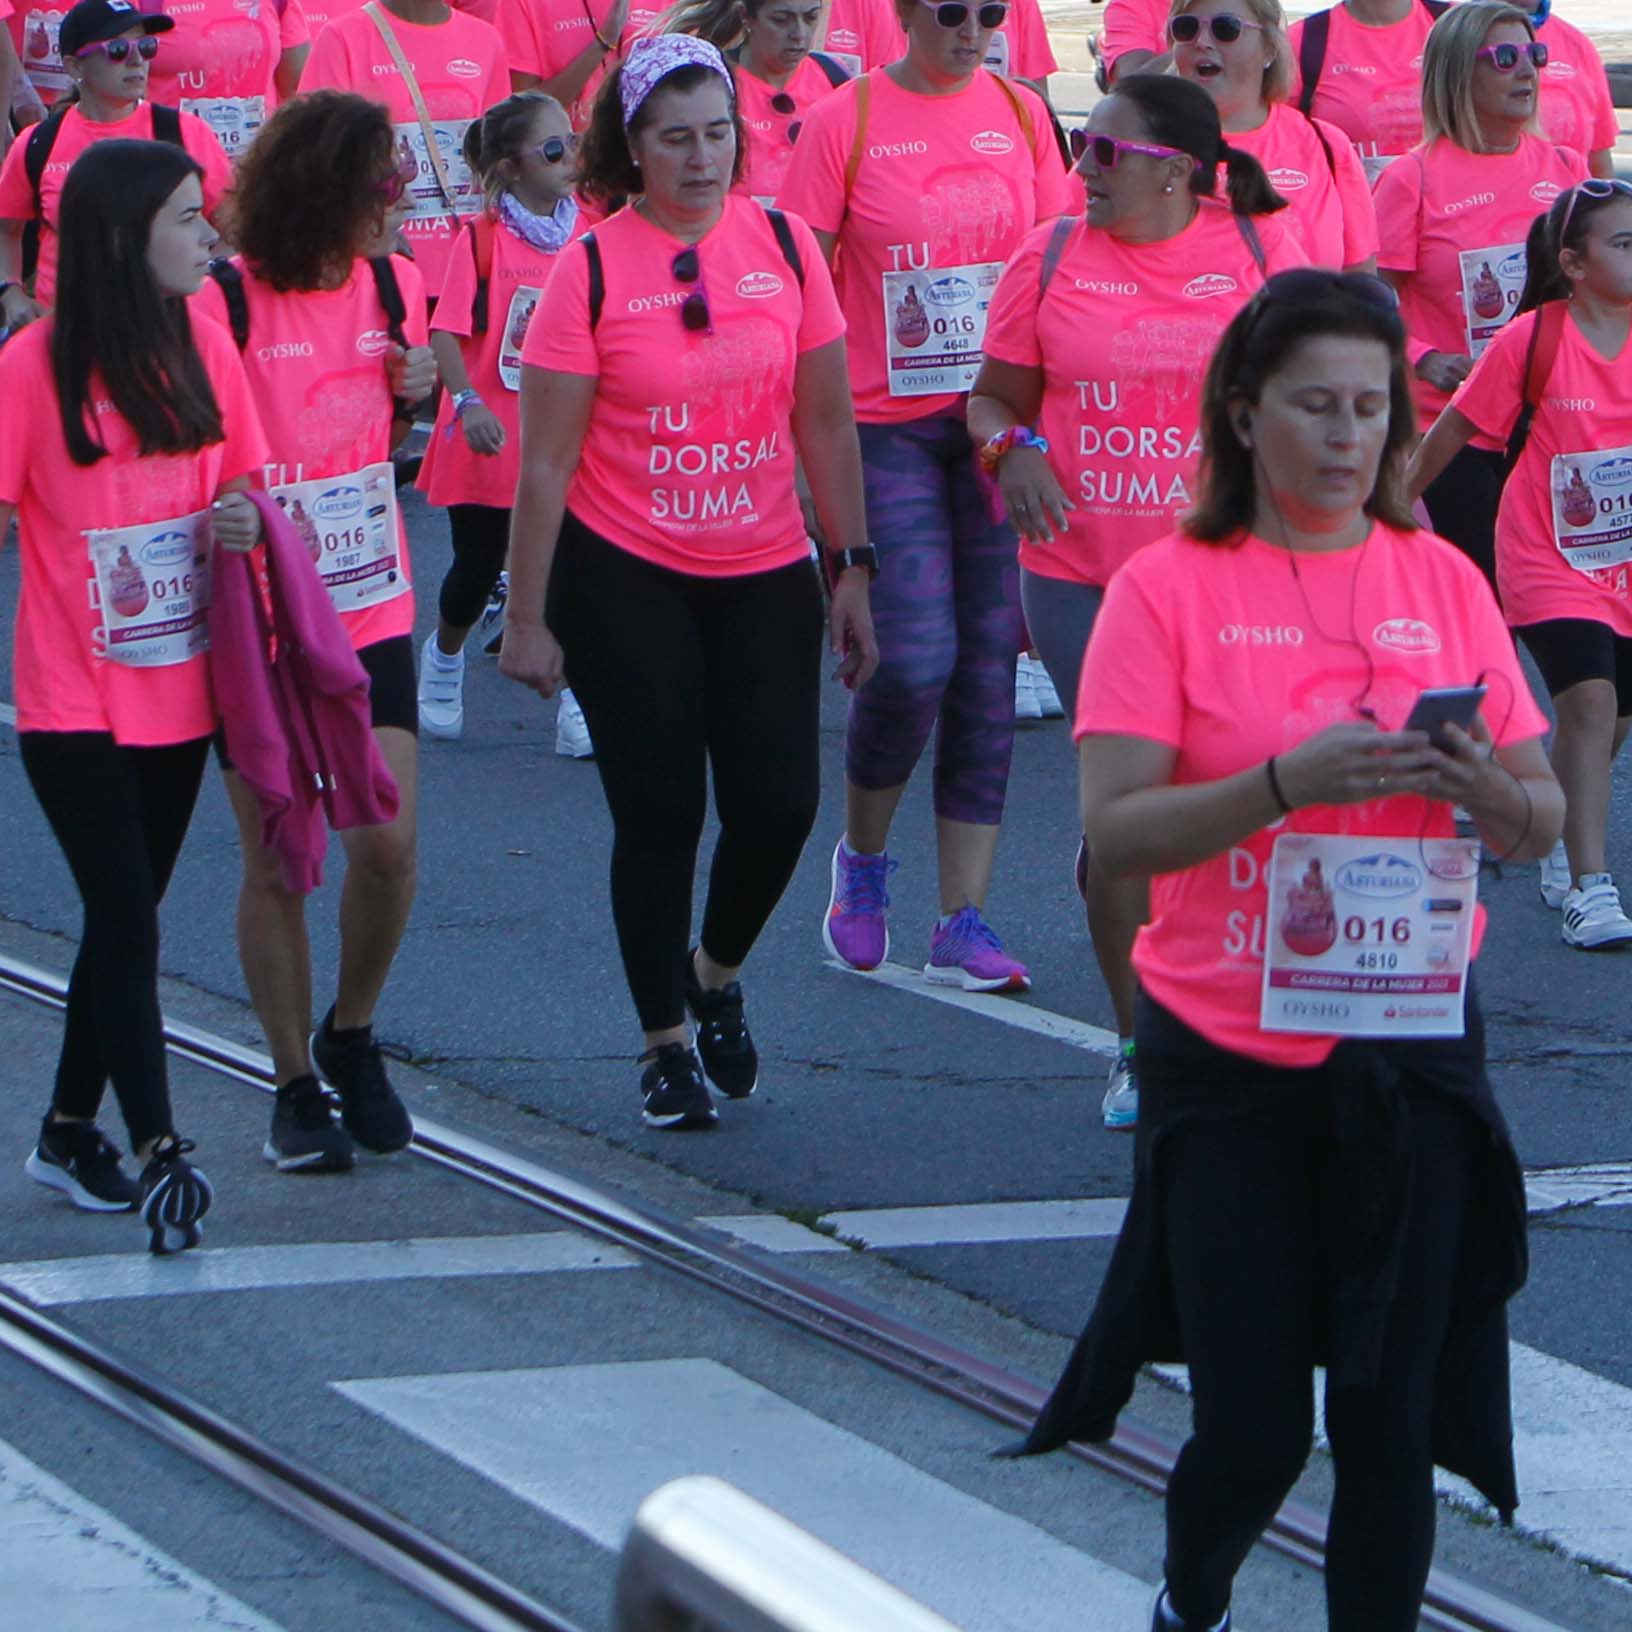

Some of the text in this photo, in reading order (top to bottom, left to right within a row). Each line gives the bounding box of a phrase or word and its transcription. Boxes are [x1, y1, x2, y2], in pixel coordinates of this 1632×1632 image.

[179, 70, 204, 88] TU
[219, 131, 240, 143] 16
[869, 140, 928, 158] OYSHO
[1445, 192, 1495, 215] OYSHO
[887, 242, 930, 271] TU
[1076, 278, 1138, 296] OYSHO
[933, 316, 975, 335] 016
[257, 342, 313, 361] OYSHO
[901, 375, 945, 387] OYSHO
[1075, 381, 1117, 411] TU
[646, 403, 689, 434] TU
[649, 431, 779, 475] DORSAL
[1079, 424, 1205, 459] DORSA
[1079, 470, 1192, 505] SUMA
[651, 482, 753, 520] SUMA
[324, 527, 365, 551] 016
[1572, 533, 1609, 546] CARRERA
[335, 553, 361, 568] 1987
[1571, 549, 1612, 563] OYSHO
[152, 574, 193, 598] 016
[1218, 622, 1305, 647] OYSHO
[1338, 868, 1418, 891] ASTURIANA
[1344, 915, 1411, 943] 016
[1289, 974, 1349, 990] CARRERA
[1352, 977, 1368, 990] DE
[1370, 978, 1386, 991] LA
[1388, 978, 1424, 991] MUJER
[1282, 1001, 1449, 1018] OYSHO Santander
